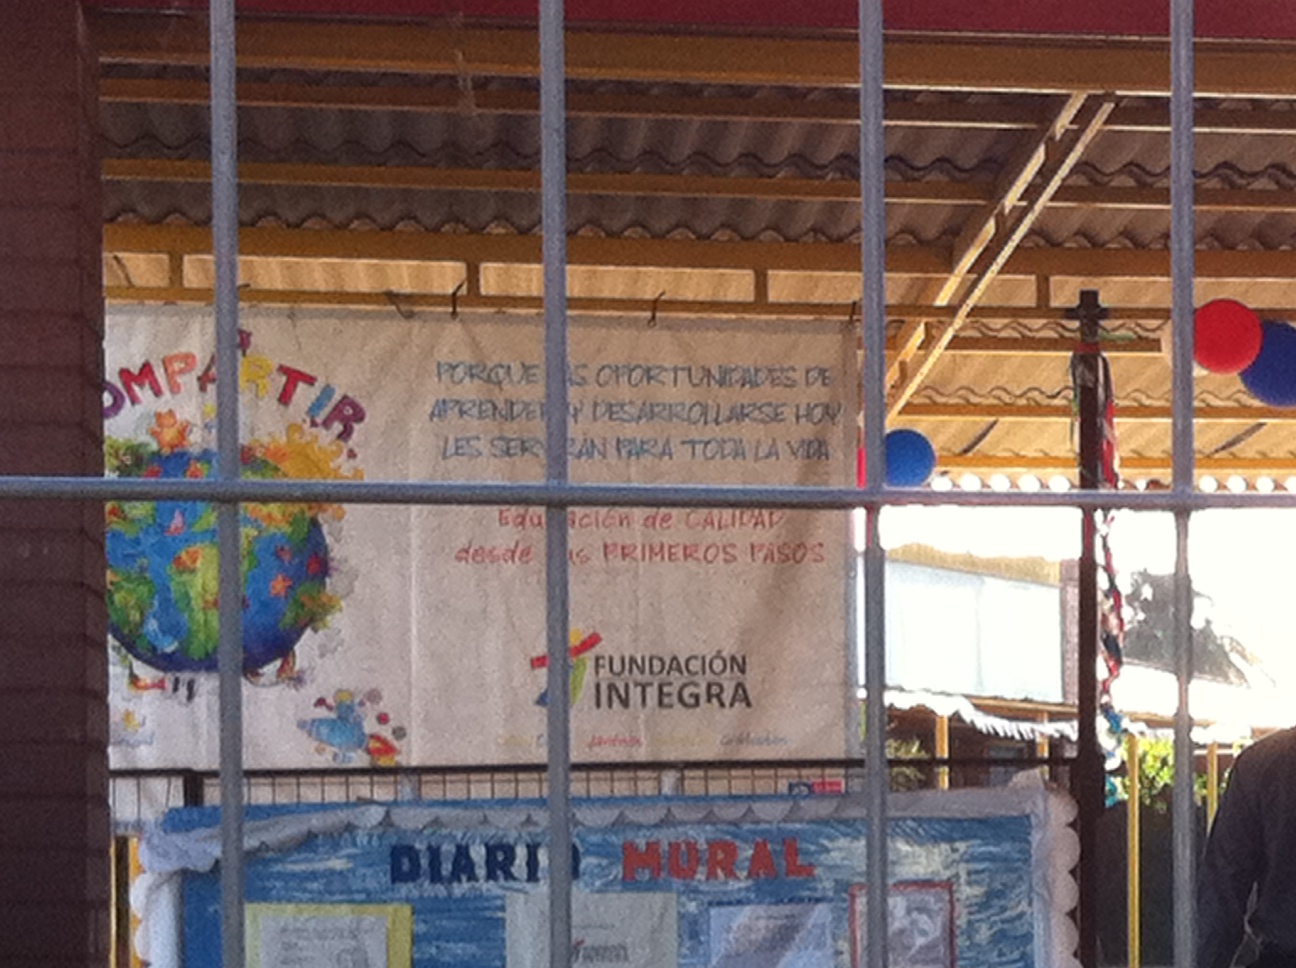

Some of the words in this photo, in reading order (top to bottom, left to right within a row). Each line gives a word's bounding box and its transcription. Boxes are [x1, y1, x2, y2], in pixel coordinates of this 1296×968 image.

[437, 361, 540, 391] PORQUE
[596, 363, 797, 388] OPORTUNIDADES
[805, 365, 831, 387] DE
[593, 399, 787, 426] DESARROLLARSE
[795, 402, 842, 426] HOY
[442, 436, 482, 460] LES
[616, 437, 673, 460] PARA
[680, 437, 746, 461] TODA
[754, 438, 780, 462] LA
[786, 438, 829, 461] VIDA
[498, 507, 631, 530] Eduación
[643, 508, 672, 530] de
[685, 507, 785, 530] CALIDAD
[455, 539, 533, 564] desde
[602, 541, 738, 564] PRIMEROS
[750, 541, 825, 564] PASOS
[593, 649, 747, 676] FUNDACIÓN
[593, 682, 753, 709] INTEGRA
[622, 837, 817, 883] MURAL
